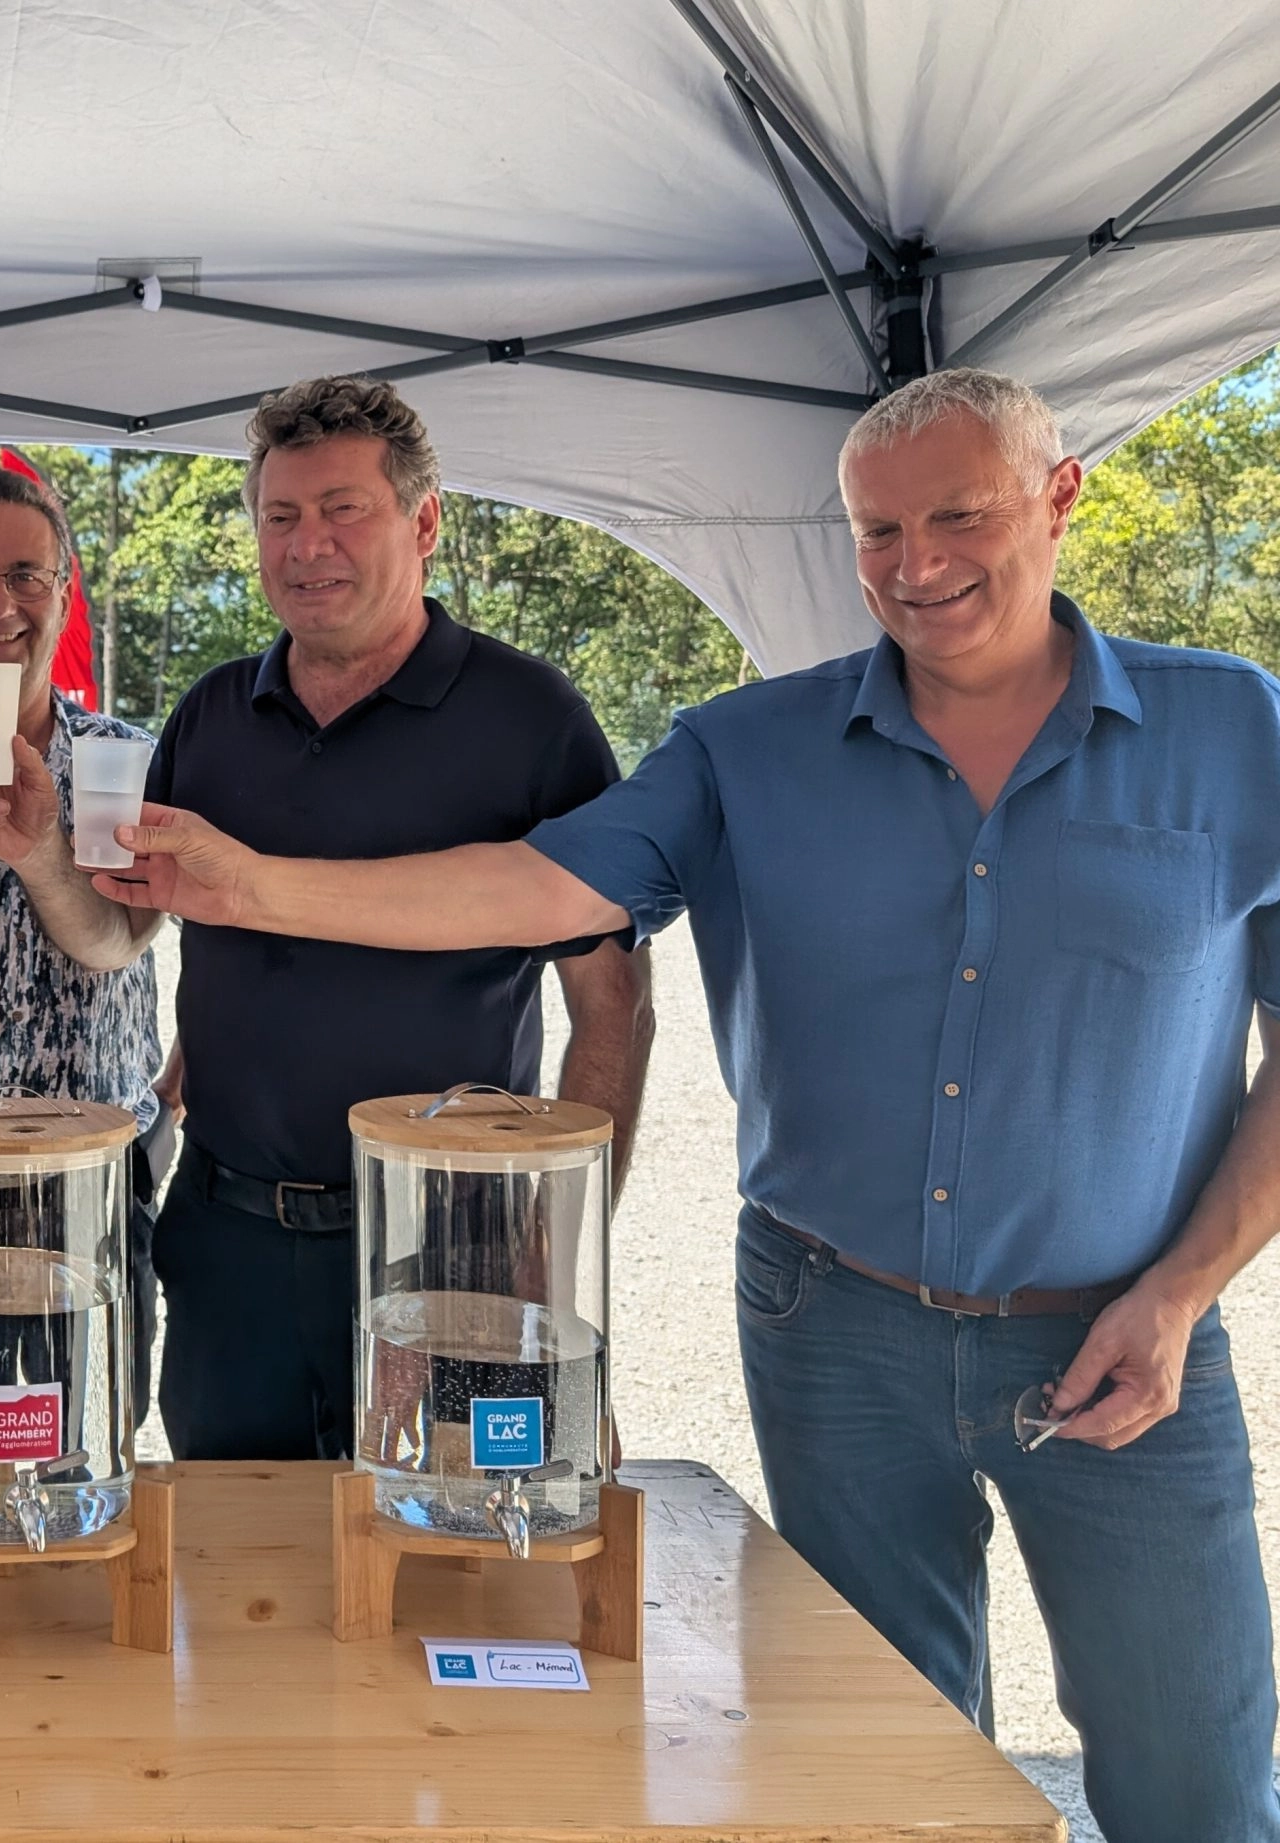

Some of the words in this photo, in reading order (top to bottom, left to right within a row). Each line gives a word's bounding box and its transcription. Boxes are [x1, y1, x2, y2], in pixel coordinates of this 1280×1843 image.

[487, 1413, 527, 1423] GRAND
[488, 1423, 528, 1440] LAC
[500, 1659, 522, 1670] Lac
